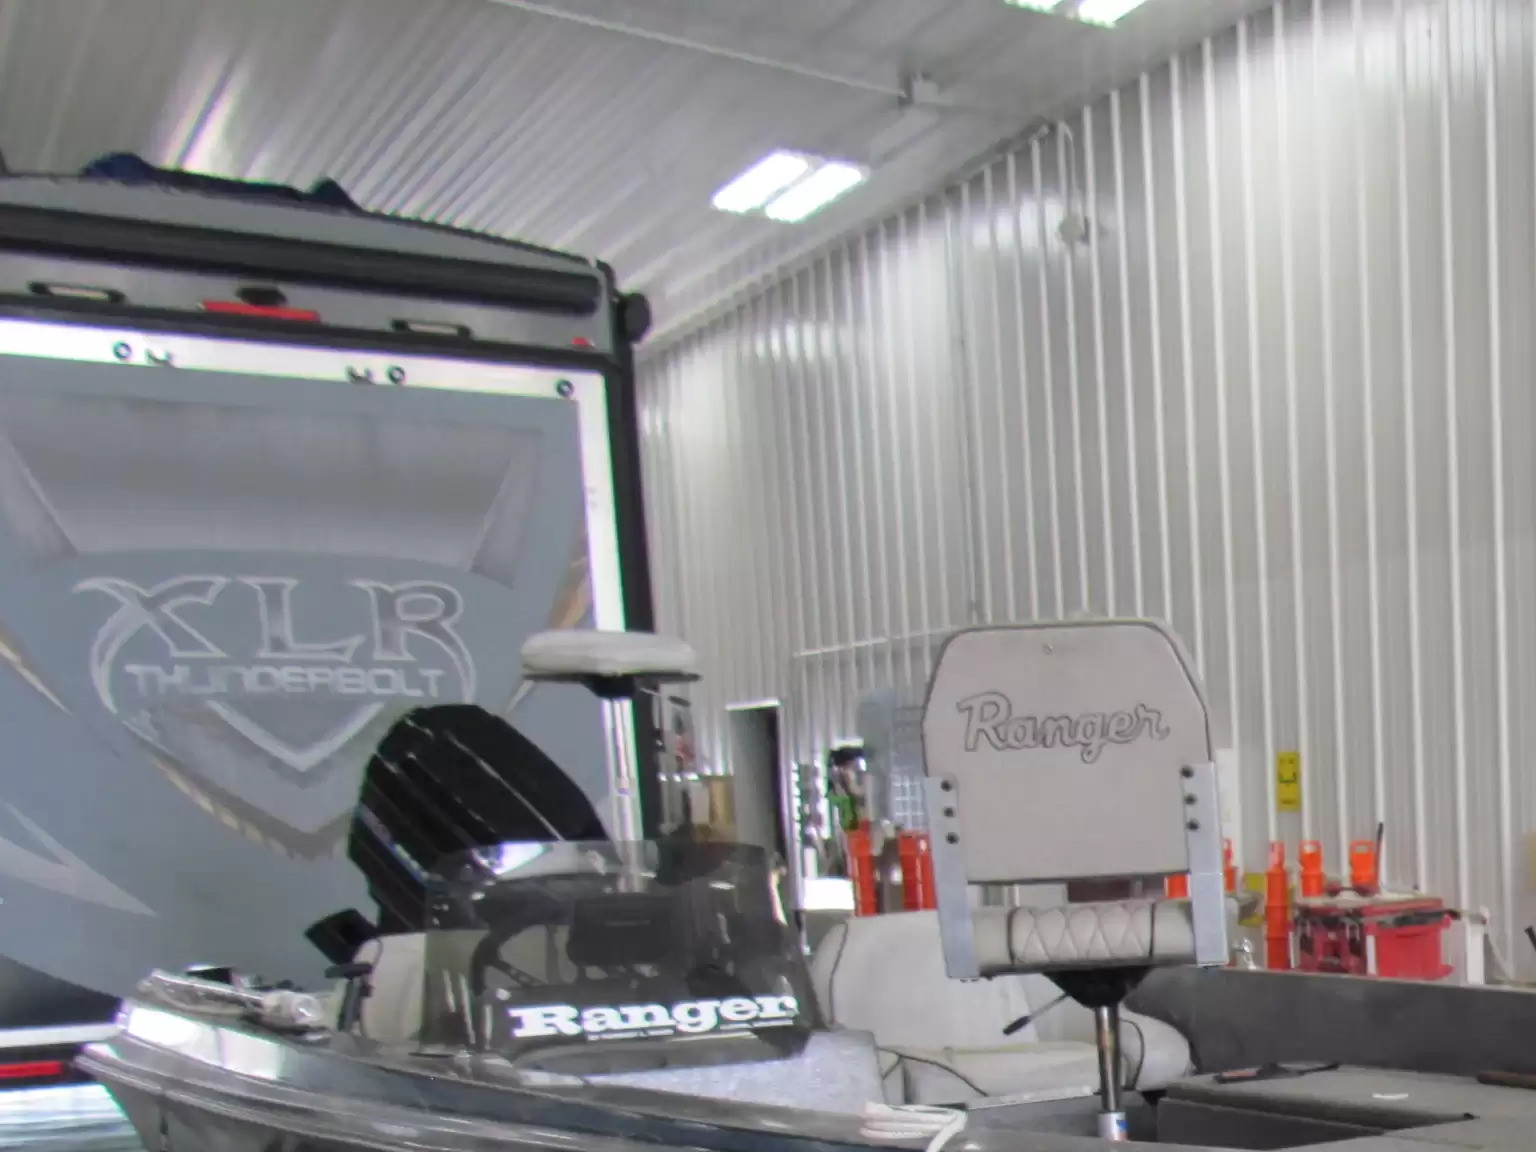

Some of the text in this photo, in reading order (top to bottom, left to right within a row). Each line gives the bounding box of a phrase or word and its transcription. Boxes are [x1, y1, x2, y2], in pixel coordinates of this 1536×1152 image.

[72, 574, 477, 713] XLR
[124, 663, 447, 698] THUNDERBOLT
[956, 691, 1171, 764] Ranger
[508, 994, 799, 1037] Ranger
